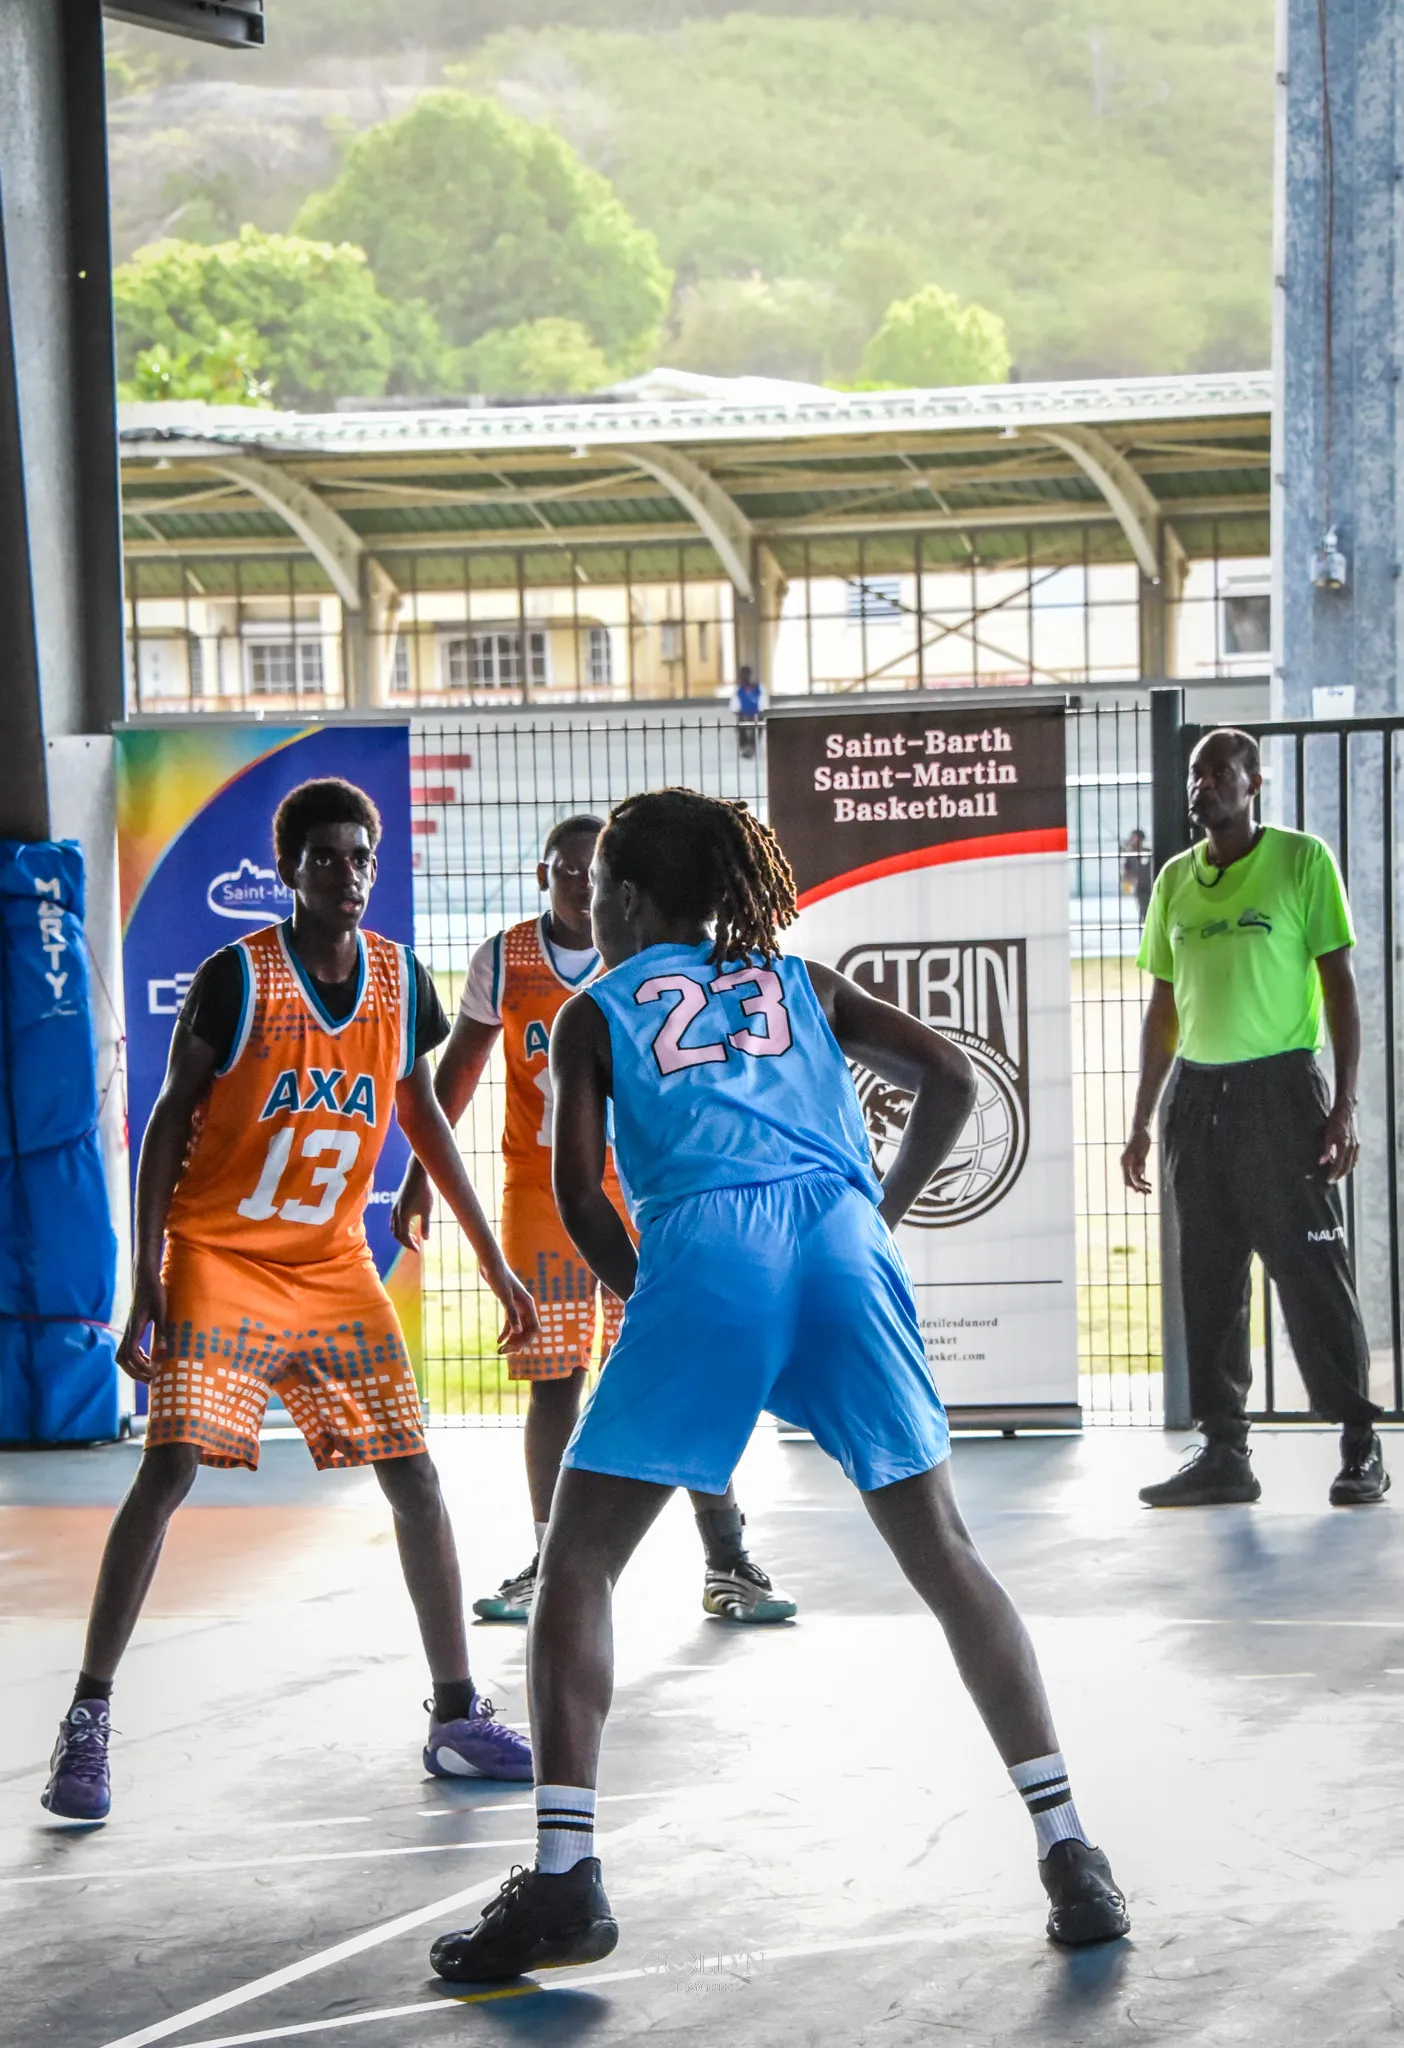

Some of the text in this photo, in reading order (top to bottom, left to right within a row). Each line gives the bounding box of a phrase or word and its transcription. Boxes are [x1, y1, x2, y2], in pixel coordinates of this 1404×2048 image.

[825, 728, 1013, 759] Saint-Barth
[813, 759, 1018, 791] Saint-Martin
[834, 793, 998, 822] Basketball
[633, 966, 793, 1077] 23
[257, 1067, 377, 1128] AXA
[237, 1127, 361, 1225] 13
